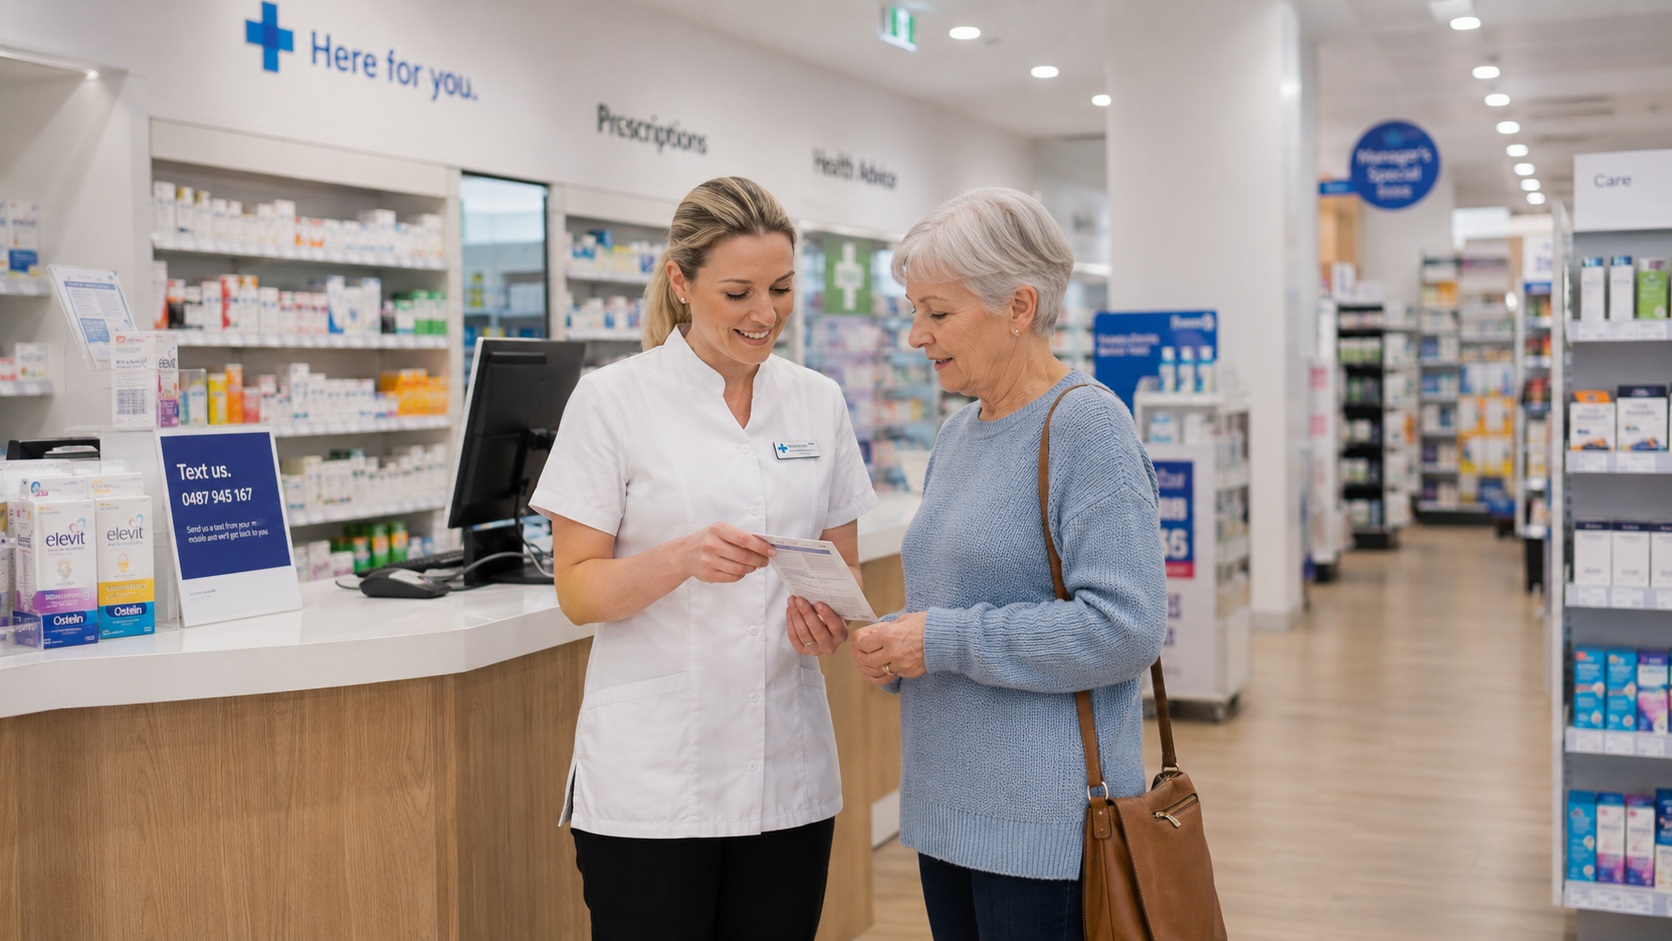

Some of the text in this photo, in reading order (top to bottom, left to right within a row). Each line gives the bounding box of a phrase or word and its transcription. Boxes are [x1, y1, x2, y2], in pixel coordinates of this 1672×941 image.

[311, 31, 478, 101] Here for you.
[597, 103, 707, 154] Prescriptions
[1594, 173, 1632, 189] Care
[176, 463, 232, 480] Text us.
[182, 487, 252, 507] 0487 945 167
[46, 532, 86, 547] elevit
[106, 527, 144, 541] elevit
[114, 605, 142, 616] Ostein
[53, 614, 84, 626] Ostein
